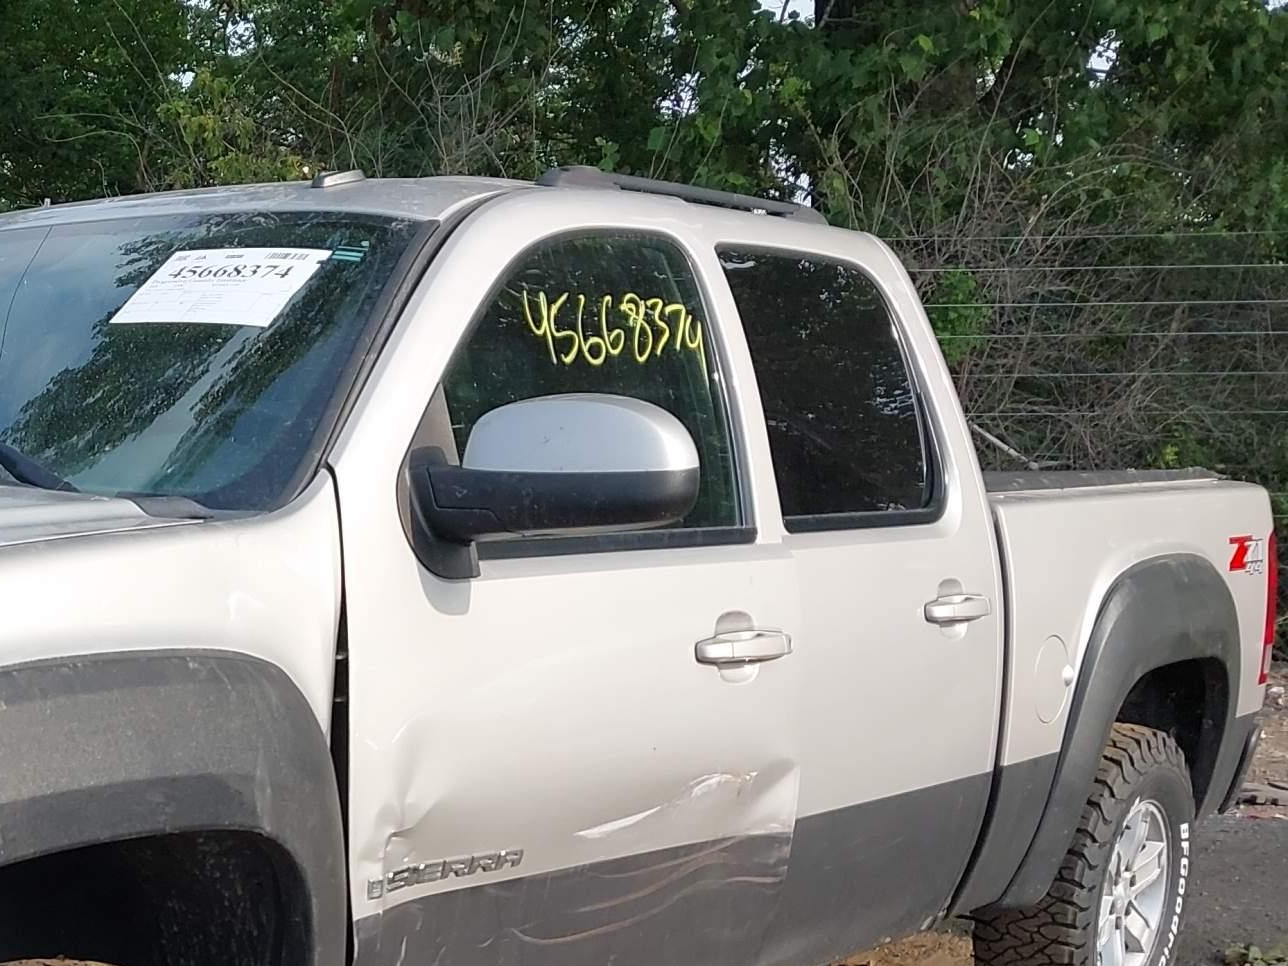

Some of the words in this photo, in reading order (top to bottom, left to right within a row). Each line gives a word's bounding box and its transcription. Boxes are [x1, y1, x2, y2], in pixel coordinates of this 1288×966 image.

[168, 264, 295, 279] 45668374
[522, 289, 710, 388] 45668374
[385, 847, 525, 893] SIERRA
